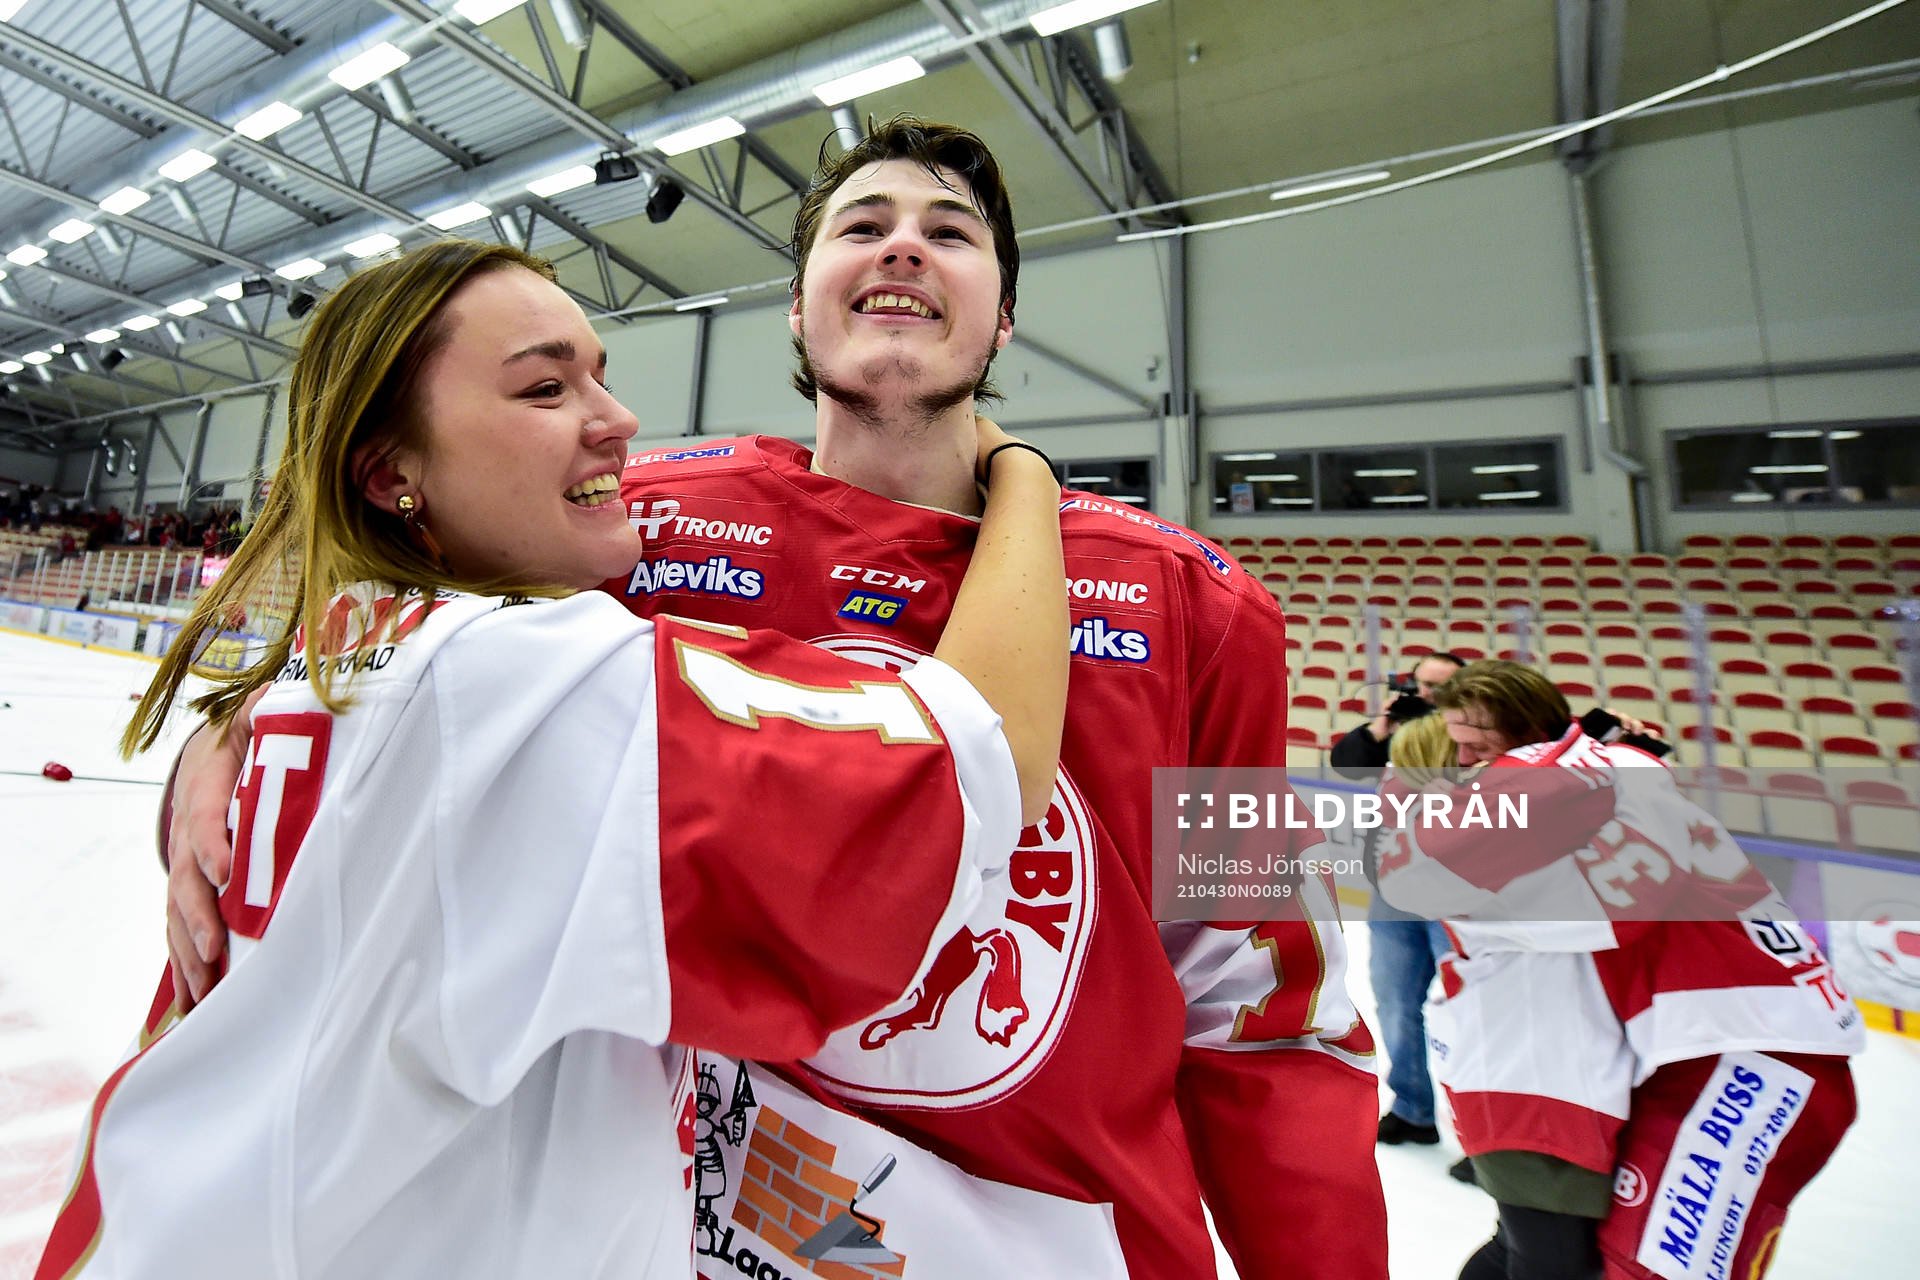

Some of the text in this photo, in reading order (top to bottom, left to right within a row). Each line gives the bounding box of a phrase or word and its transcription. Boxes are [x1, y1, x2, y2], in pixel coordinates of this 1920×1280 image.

[829, 564, 927, 593] CCM
[842, 596, 898, 619] ATG
[1659, 1065, 1765, 1269] MJÄLA BUSS
[718, 1226, 792, 1280] La
